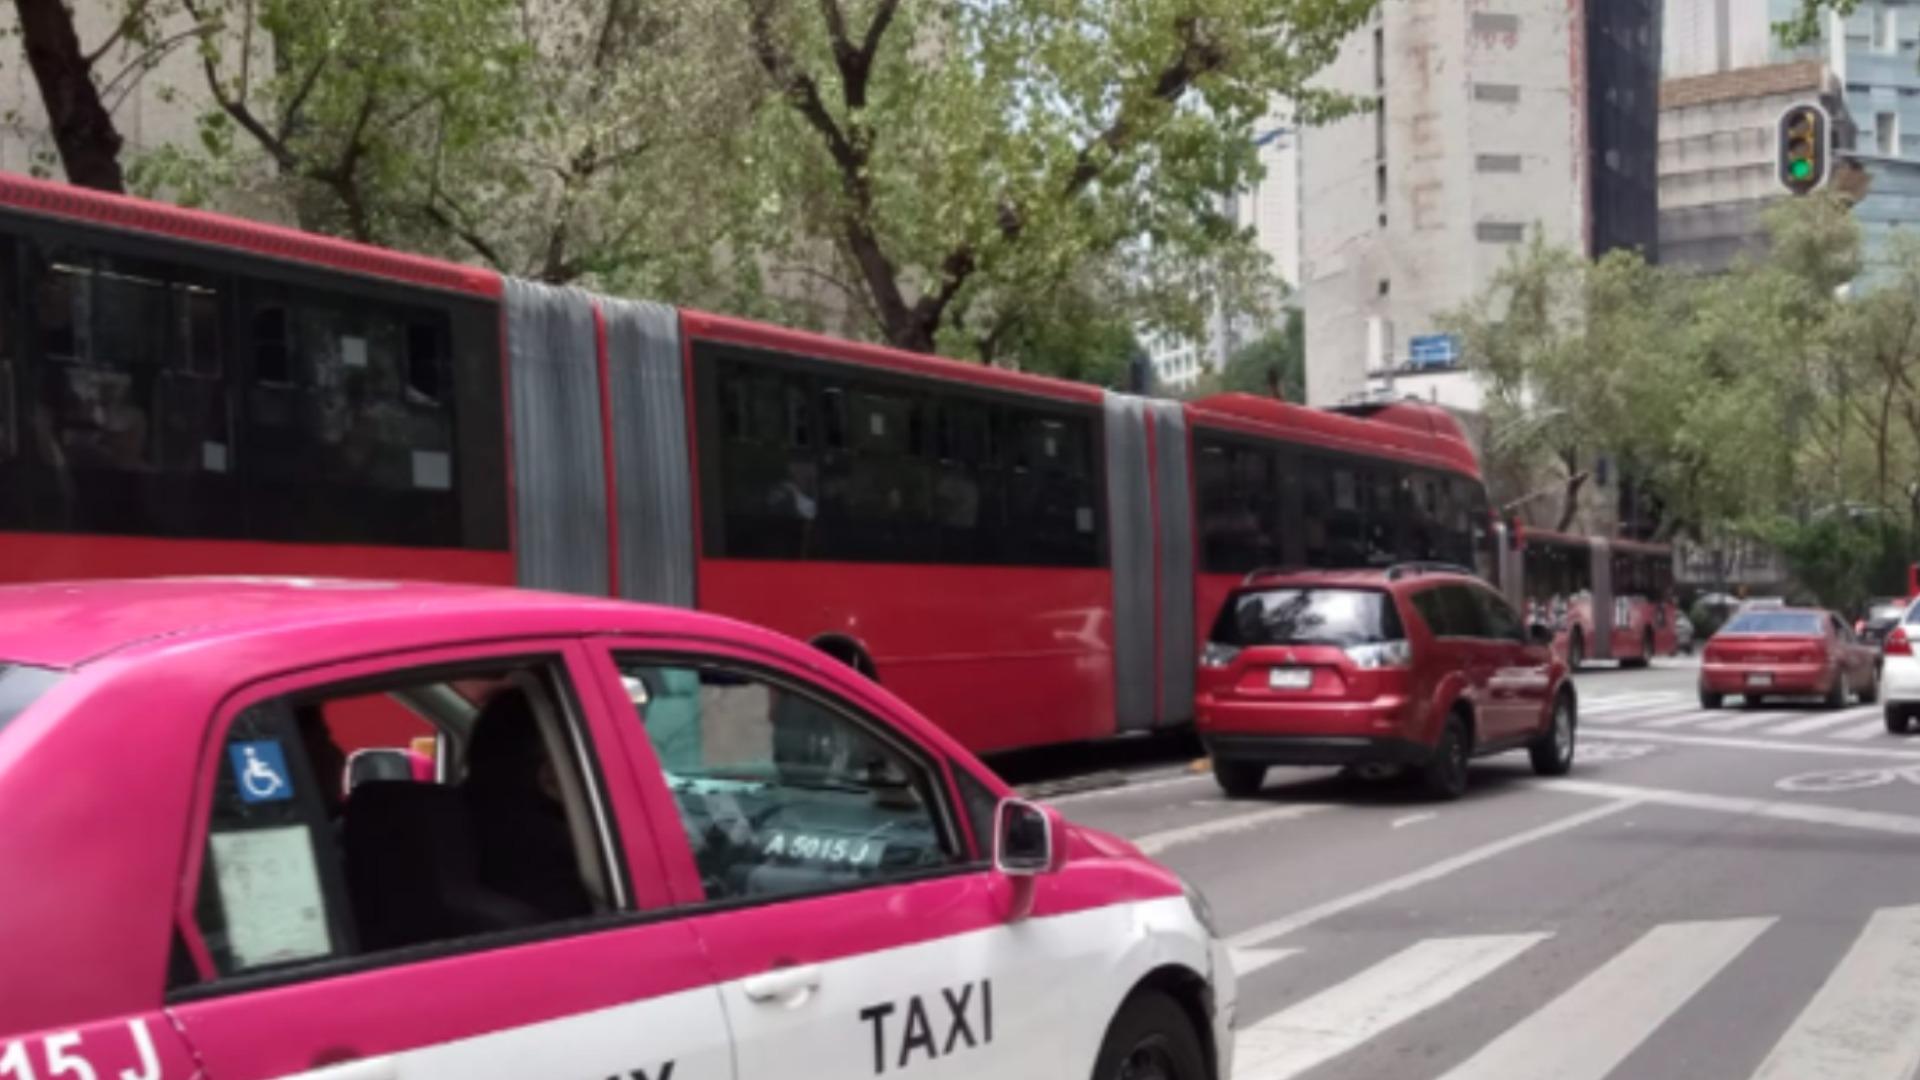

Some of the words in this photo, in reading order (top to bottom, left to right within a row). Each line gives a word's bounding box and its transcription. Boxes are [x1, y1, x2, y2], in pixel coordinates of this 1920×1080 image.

[763, 834, 785, 856] A
[789, 834, 849, 862] 5015
[849, 841, 870, 865] J
[118, 1016, 161, 1080] J
[858, 977, 993, 1075] TAXI
